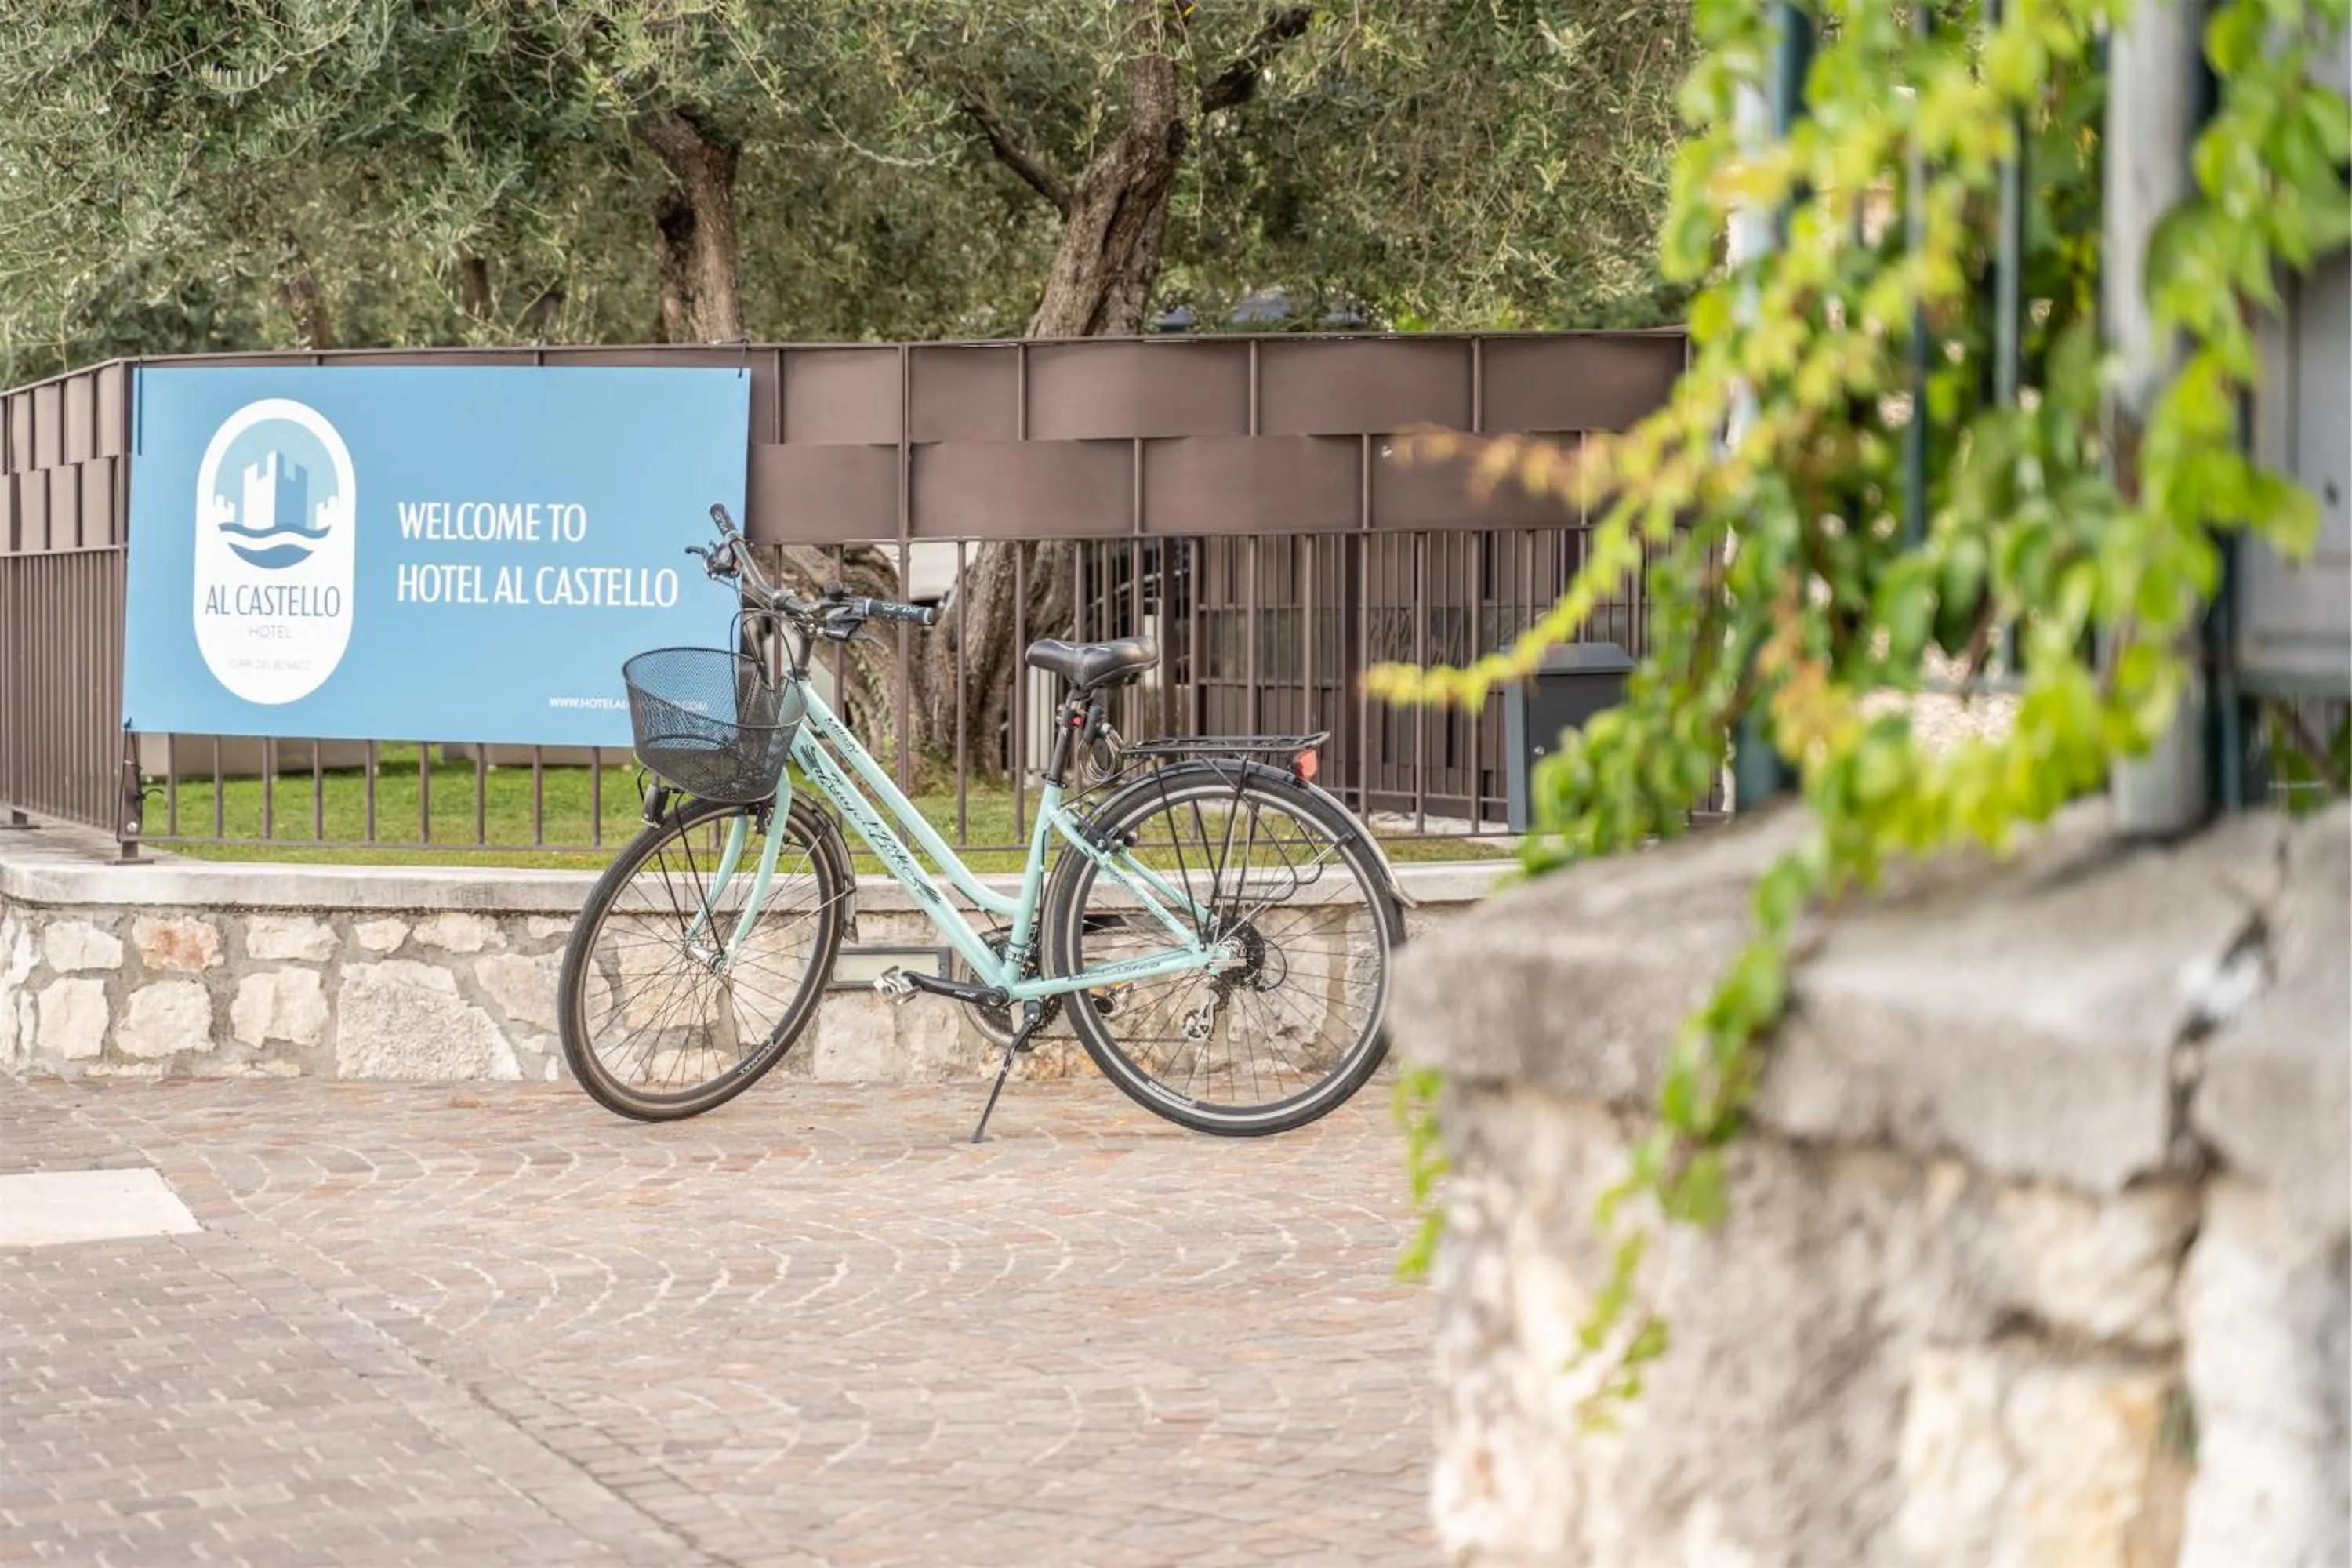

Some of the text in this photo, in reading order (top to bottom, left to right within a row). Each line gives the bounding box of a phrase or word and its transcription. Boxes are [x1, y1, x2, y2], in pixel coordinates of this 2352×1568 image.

[398, 502, 587, 542] WELCOME TO
[205, 584, 341, 618] AL CASTELLO
[397, 564, 679, 608] HOTEL AL CASTELLO
[249, 624, 293, 639] HOTEL
